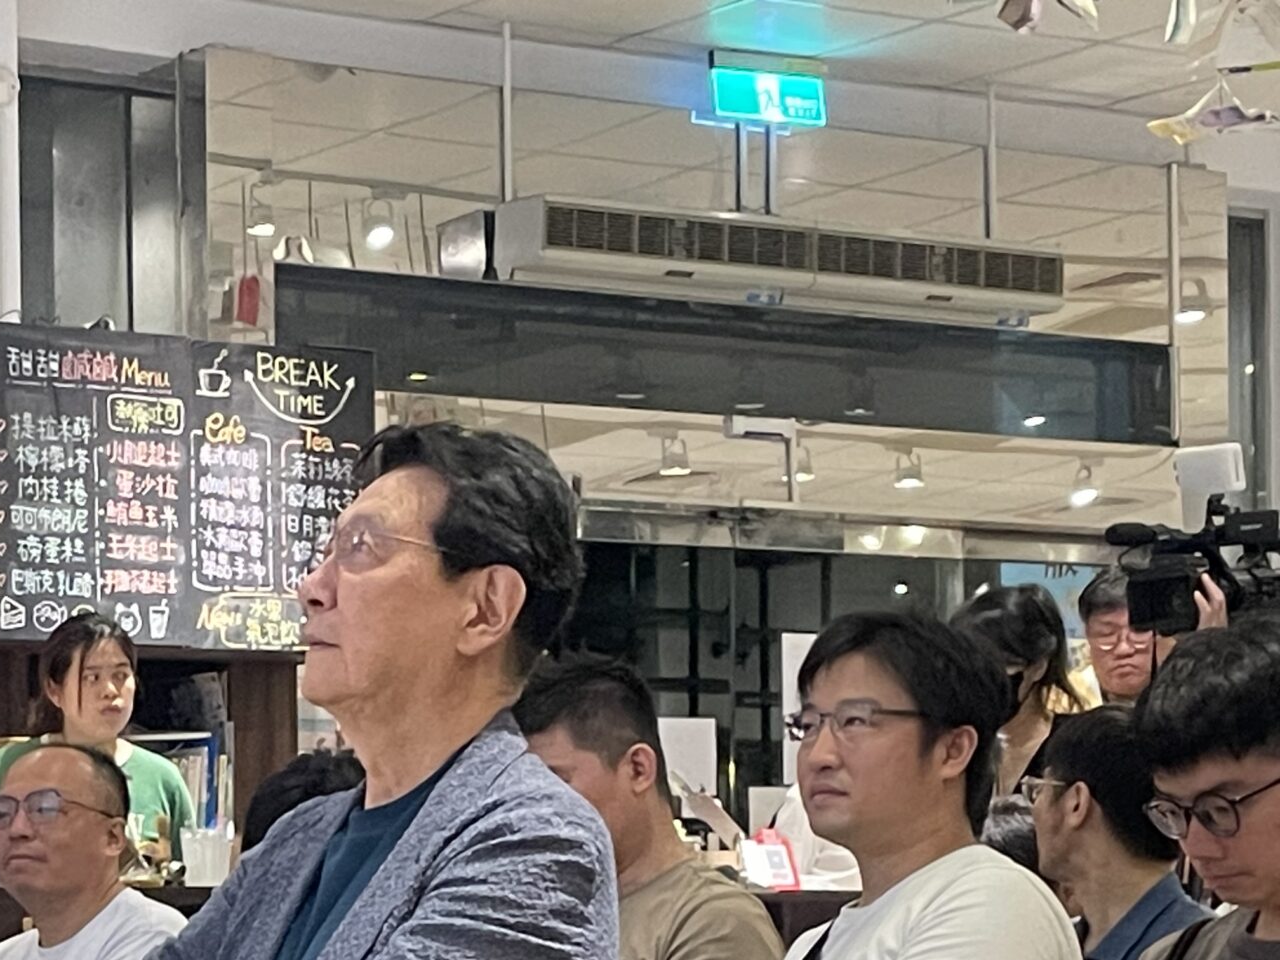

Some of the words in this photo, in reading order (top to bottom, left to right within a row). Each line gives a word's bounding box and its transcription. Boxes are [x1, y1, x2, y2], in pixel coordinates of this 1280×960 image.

[120, 357, 170, 387] Menu
[256, 351, 341, 391] BREAK
[274, 388, 326, 416] TIME
[10, 411, 91, 444] 提拉米蘇
[299, 425, 335, 453] Tea
[18, 475, 88, 506] 肉桂捲
[115, 469, 179, 499] 蛋沙拉
[105, 499, 179, 532] 鮪魚玉米
[17, 535, 87, 564] 磅蛋糕
[11, 568, 95, 598] 巴斯克乳酪
